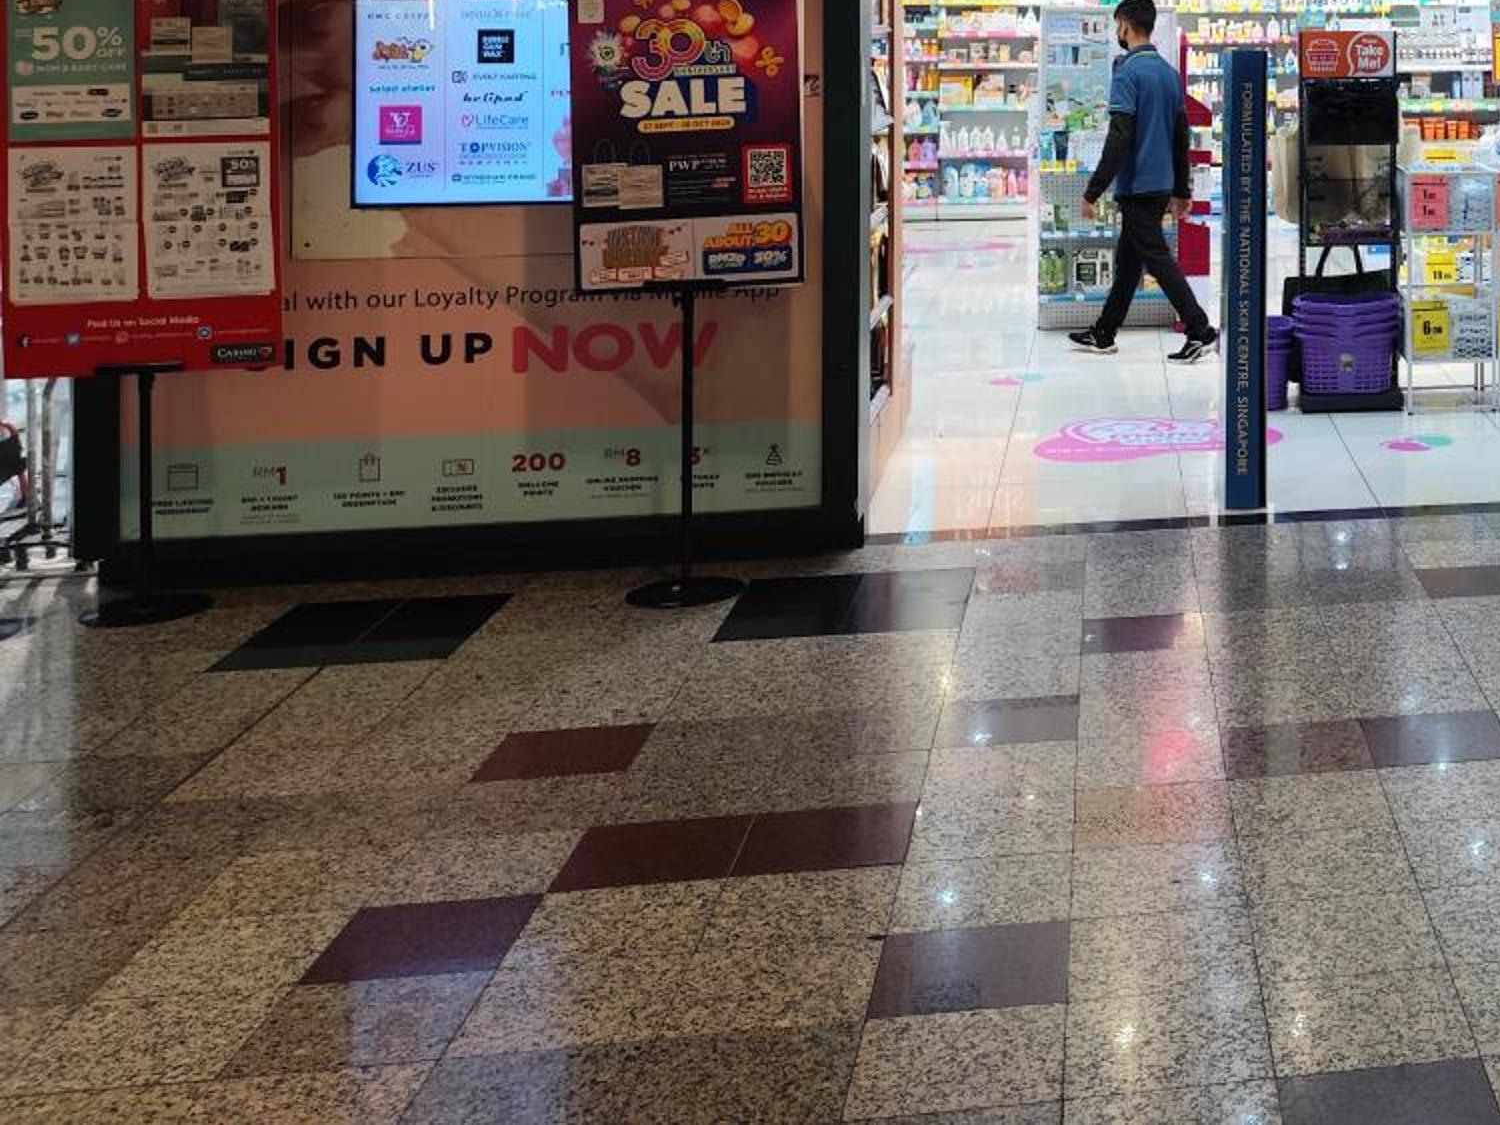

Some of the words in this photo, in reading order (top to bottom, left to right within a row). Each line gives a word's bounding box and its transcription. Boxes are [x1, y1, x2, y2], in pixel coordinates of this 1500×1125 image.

[1356, 42, 1385, 57] Take
[619, 76, 747, 118] SALE
[475, 114, 529, 126] LifeCare
[1239, 81, 1253, 172] FORMULATED
[1237, 196, 1252, 223] THE
[1237, 226, 1251, 296] NATIONAL
[306, 288, 358, 312] with
[366, 292, 406, 310] our
[414, 285, 500, 312] Loyalty
[506, 284, 602, 311] Program
[1236, 300, 1250, 332] SKIN
[268, 336, 387, 372] IGN
[420, 331, 494, 366] UP
[510, 320, 720, 374] NOW
[1234, 395, 1249, 476] SINGAPORE
[511, 452, 567, 473] 200
